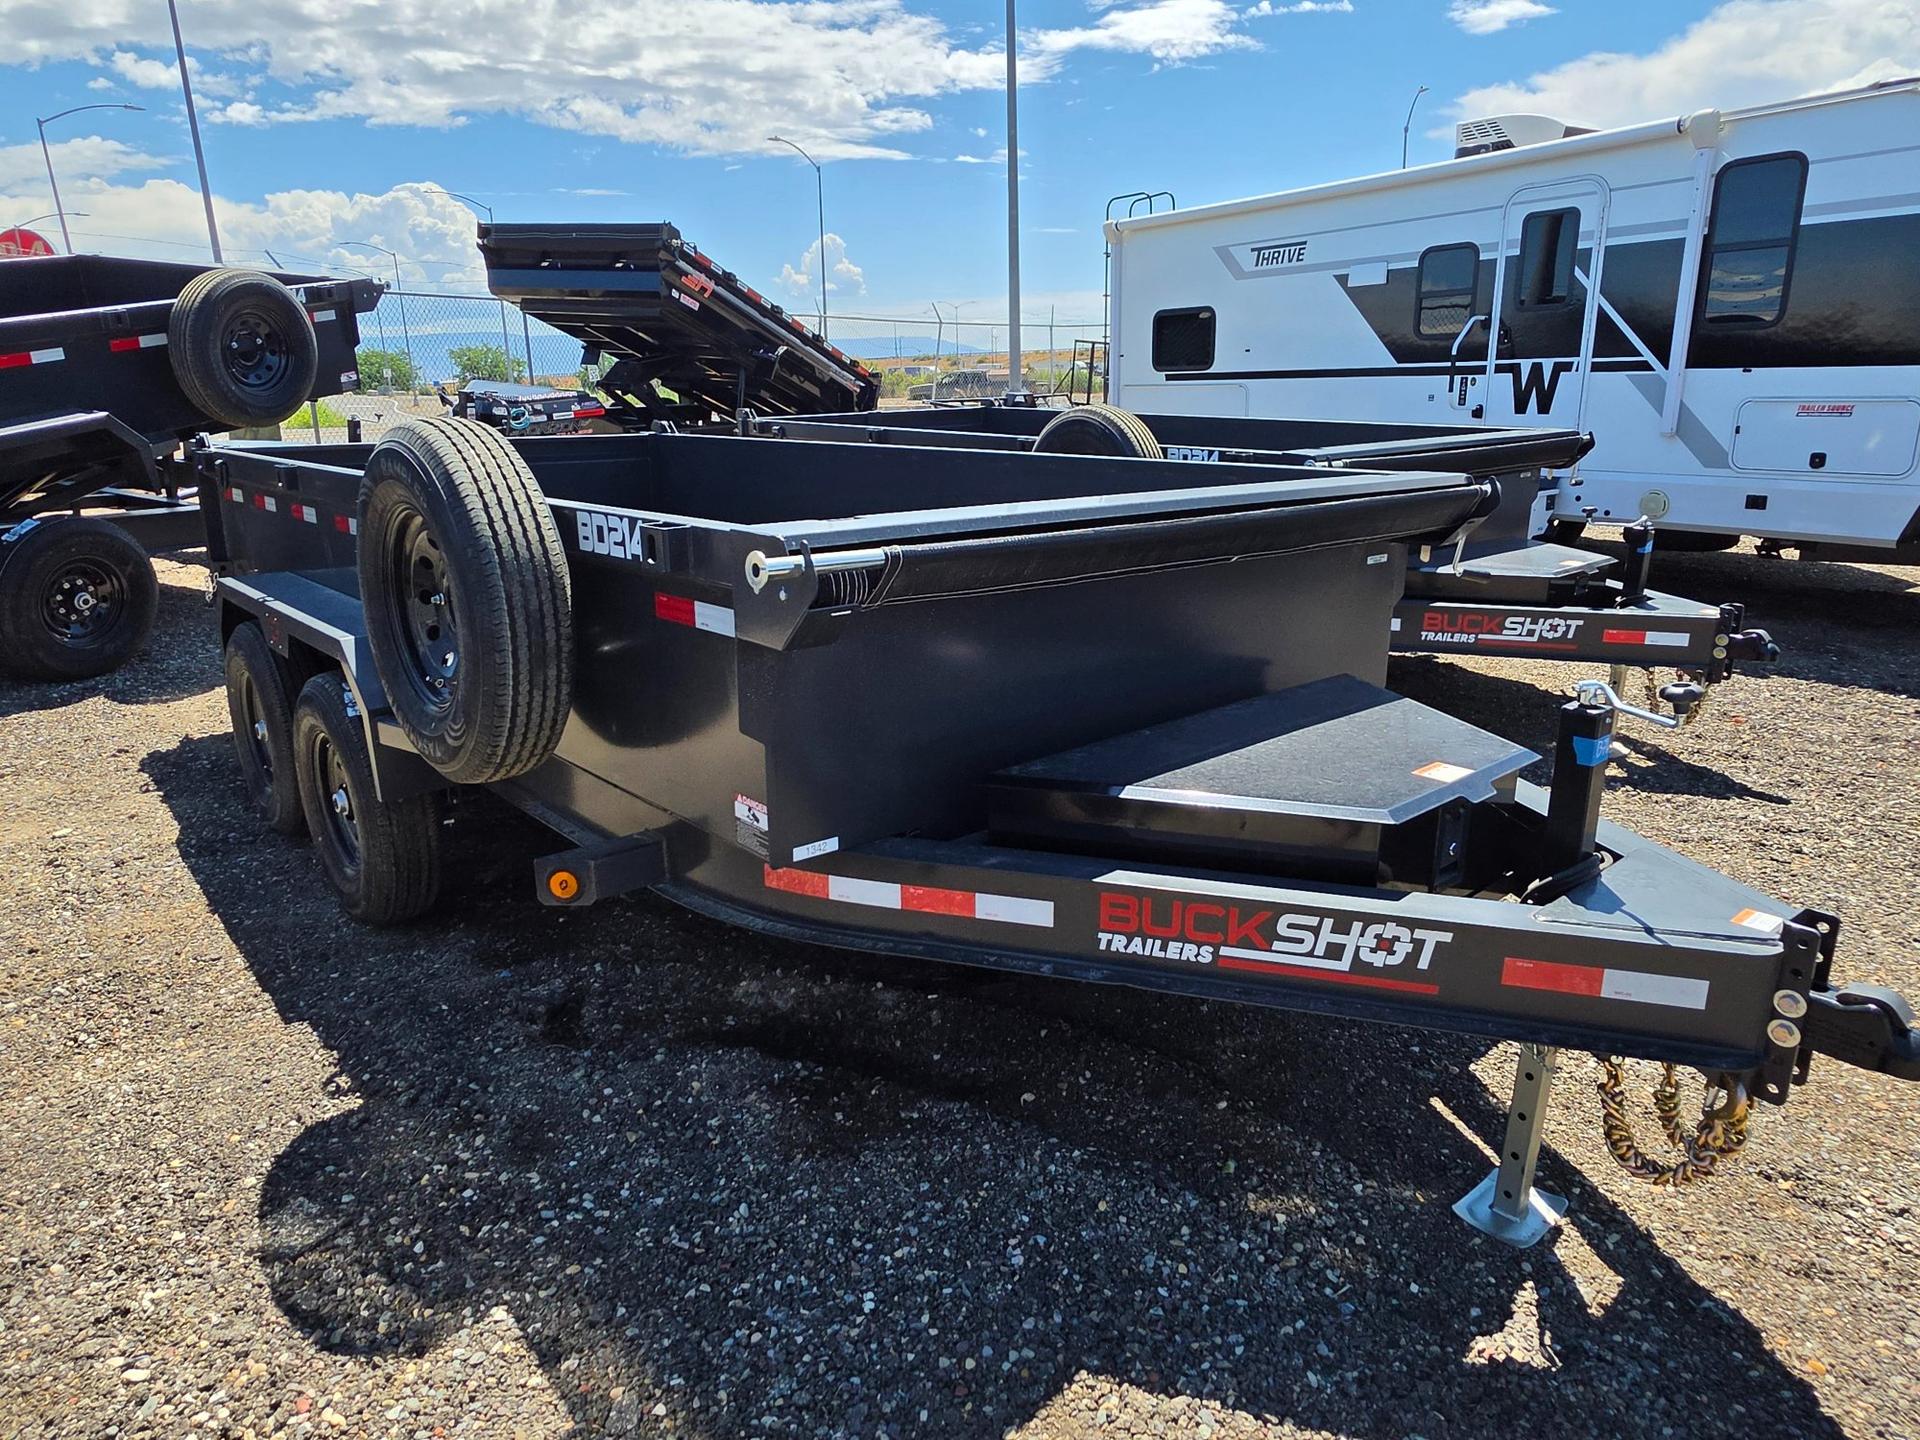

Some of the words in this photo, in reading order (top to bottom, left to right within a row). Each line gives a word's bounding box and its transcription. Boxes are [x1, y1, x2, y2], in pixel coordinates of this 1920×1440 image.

[1250, 240, 1308, 268] THRIVE
[1494, 361, 1575, 415] W
[576, 511, 643, 562] BD214
[1420, 631, 1476, 643] TRAILERS
[1423, 612, 1584, 642] BUCKSHOT
[806, 842, 828, 856] 1342
[1098, 892, 1454, 972] BUCKSHOT
[1097, 932, 1215, 964] TRAILERS
